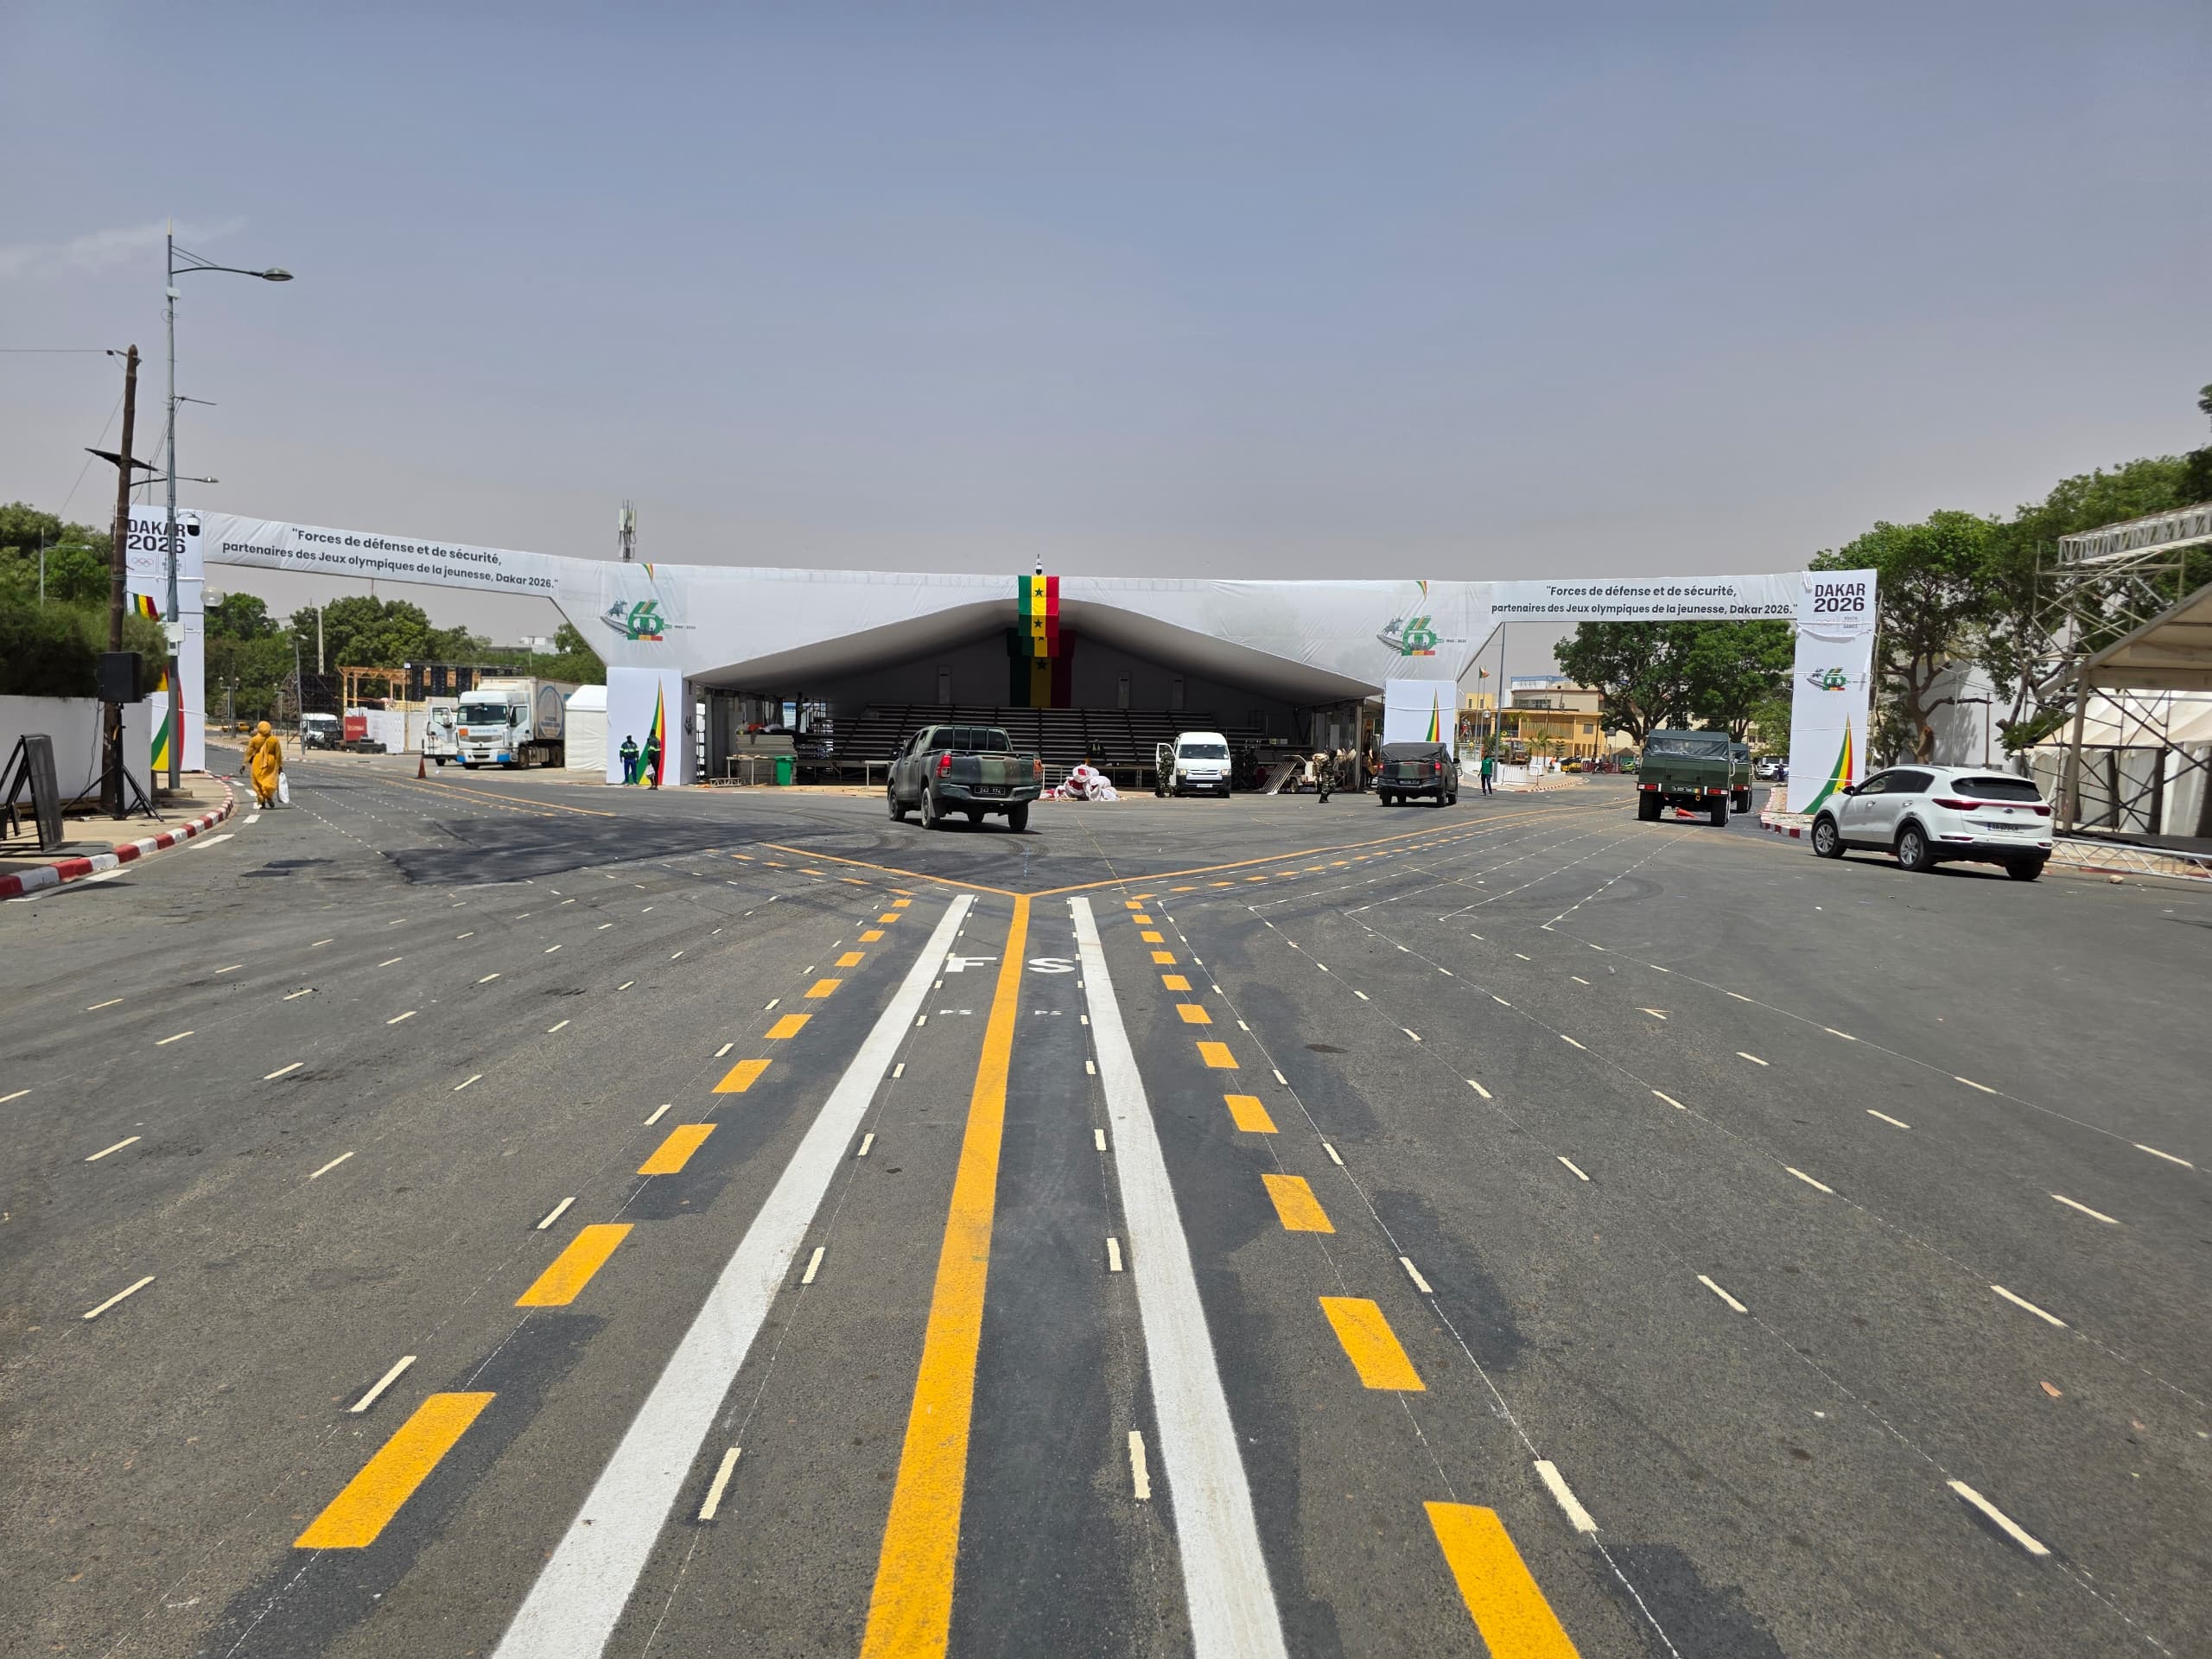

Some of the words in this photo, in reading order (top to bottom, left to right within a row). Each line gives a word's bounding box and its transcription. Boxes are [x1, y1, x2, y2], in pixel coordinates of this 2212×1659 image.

[128, 535, 186, 553] 2026
[292, 528, 341, 544] "Forces
[345, 536, 360, 546] de
[363, 537, 415, 553] défense
[417, 545, 429, 555] et
[432, 546, 448, 557] de
[449, 549, 502, 566] sécurité,
[222, 542, 293, 557] partenaires
[296, 550, 316, 561] des
[319, 552, 346, 564] Jeux
[348, 556, 415, 573] olympiques
[416, 563, 430, 574] de
[432, 564, 442, 575] la
[443, 565, 494, 582] jeunesse,
[495, 573, 527, 585] Dakar
[529, 576, 558, 588] 2026."
[1547, 586, 1586, 596] "Forces
[1589, 586, 1603, 596] de
[1605, 585, 1650, 596] défense
[1653, 587, 1665, 596] et
[1667, 586, 1681, 596] de
[1684, 585, 1737, 598] sécurité,
[1815, 583, 1866, 597] DAKAR
[1491, 603, 1546, 614] partenaires
[1548, 603, 1564, 613] des
[1566, 604, 1589, 613] Jeux
[1591, 603, 1650, 616] olympiques
[1651, 603, 1665, 613] de
[1666, 604, 1676, 613] la
[1677, 603, 1727, 615] jeunesse,
[1730, 604, 1763, 614] Dakar
[1764, 603, 1798, 614] 2026."
[1815, 597, 1865, 613] 2026
[945, 957, 997, 973] F
[1028, 957, 1075, 973] S
